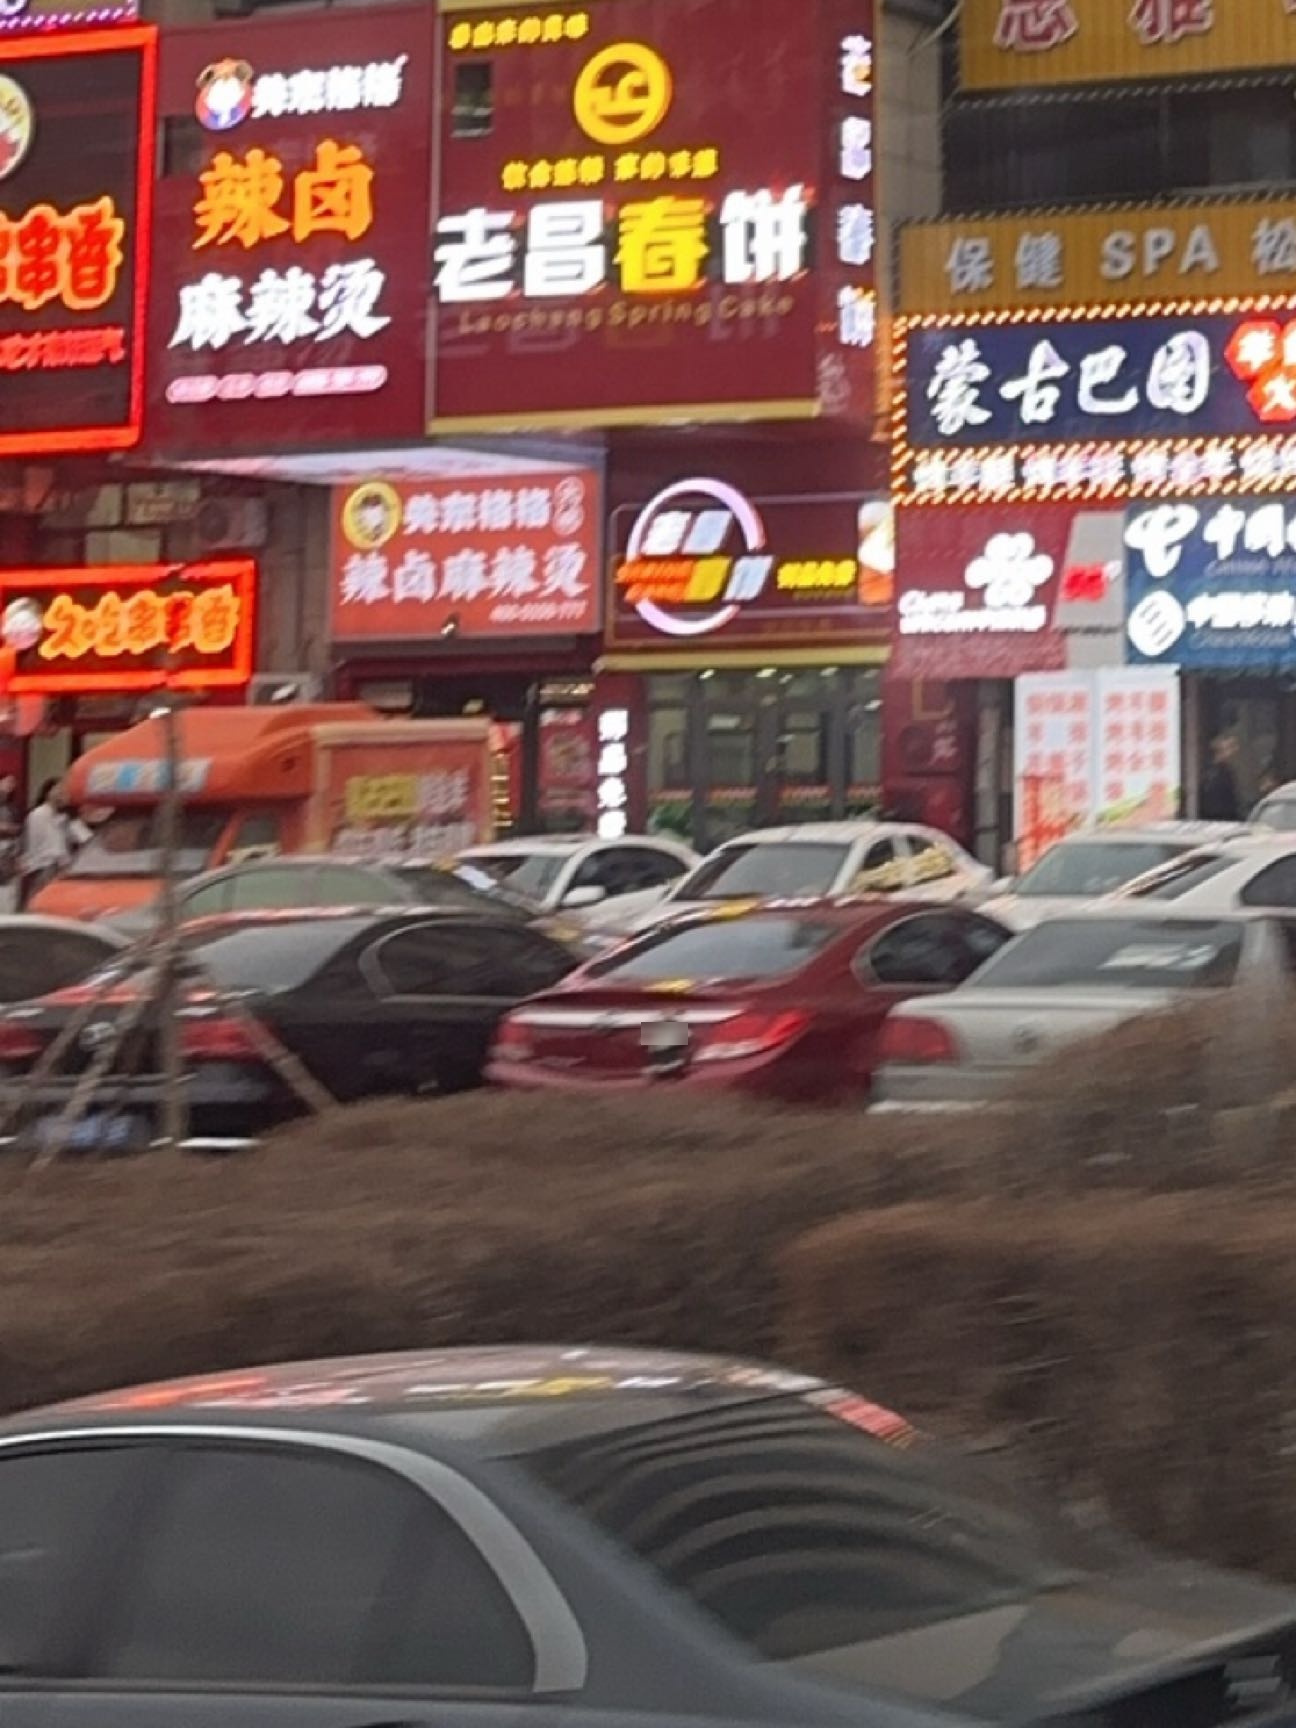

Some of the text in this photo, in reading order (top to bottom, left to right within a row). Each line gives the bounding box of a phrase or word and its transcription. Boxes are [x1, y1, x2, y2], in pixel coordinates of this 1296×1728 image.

[191, 138, 374, 249] 辣卤
[434, 183, 806, 303] 老昌春饼
[0, 194, 125, 310] 串香
[946, 232, 1064, 294] 保健
[1100, 224, 1220, 279] SPA
[168, 258, 391, 352] 麻辣烫
[339, 542, 593, 606] 辣卤麻辣烫
